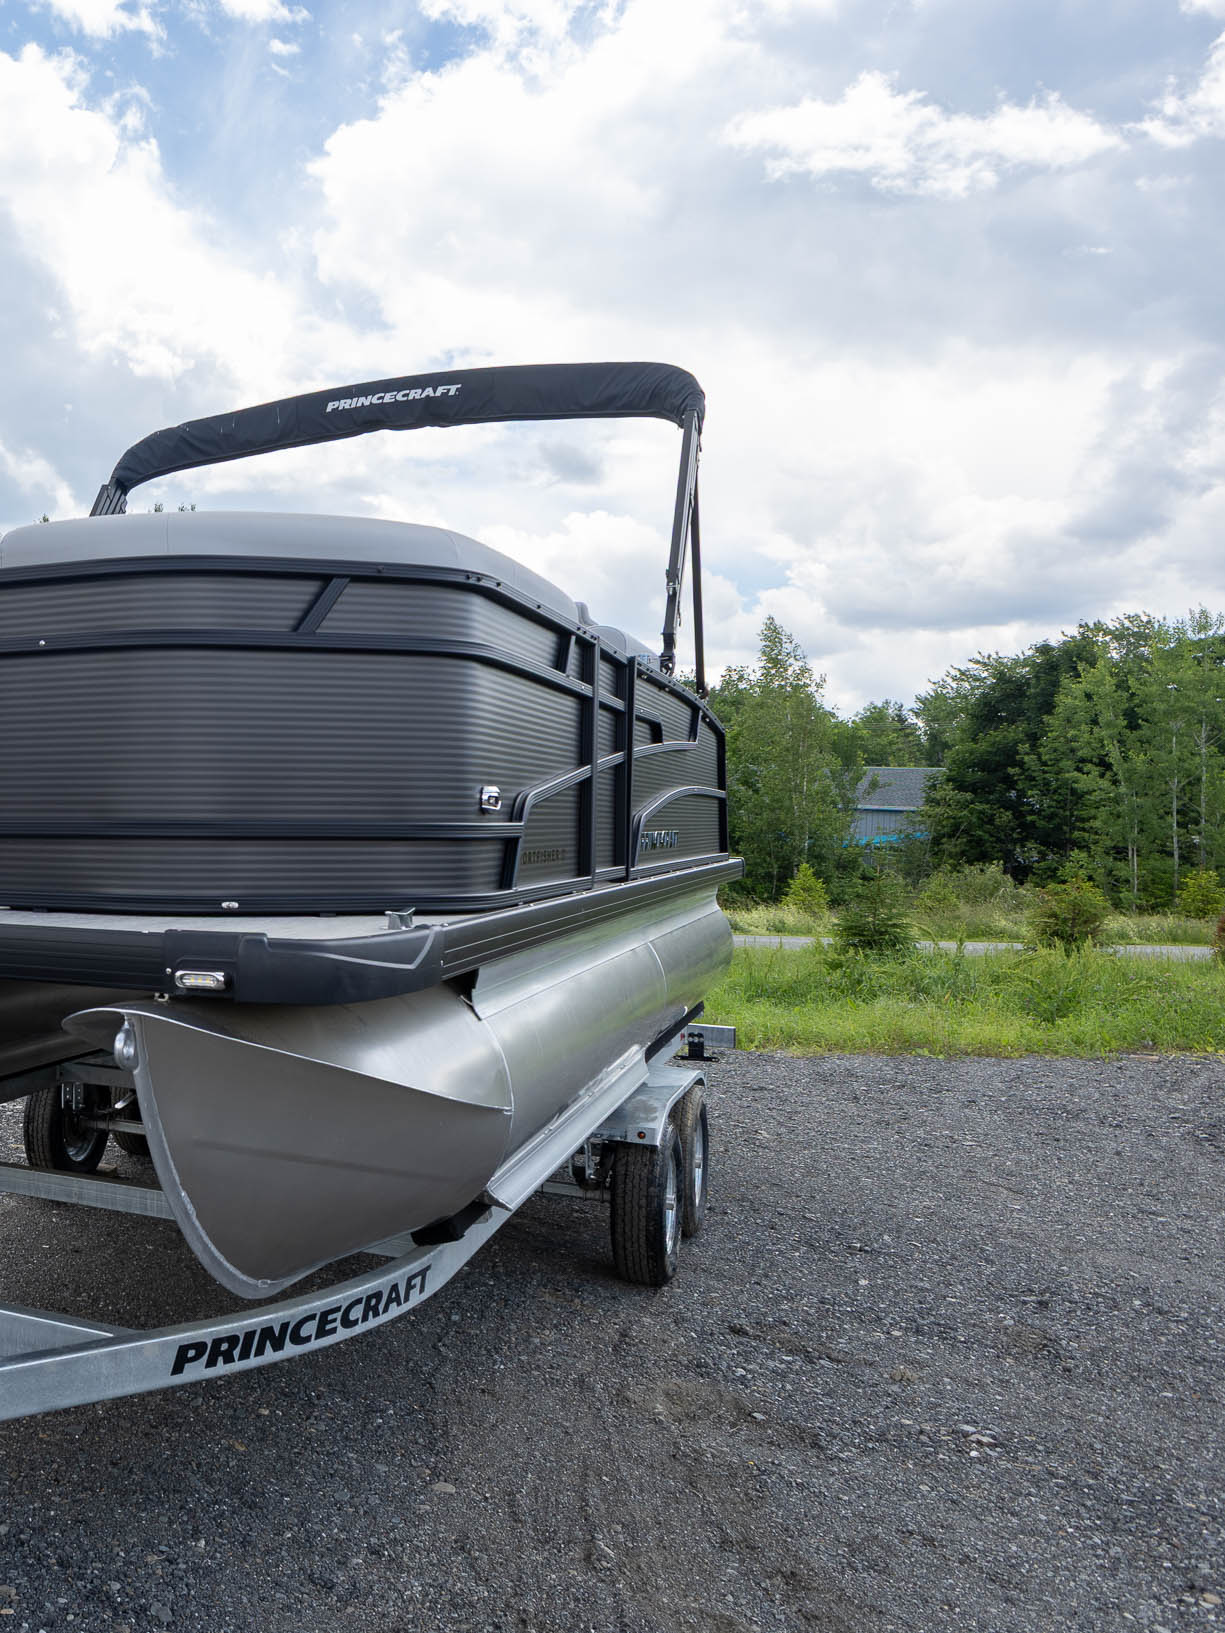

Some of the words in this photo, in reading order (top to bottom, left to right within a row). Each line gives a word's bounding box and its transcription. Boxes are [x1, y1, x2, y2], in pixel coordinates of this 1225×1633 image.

[326, 384, 461, 413] PRINCECRAFT
[520, 849, 561, 865] ORTFISHER
[170, 1263, 432, 1376] PRINCECRAFT
